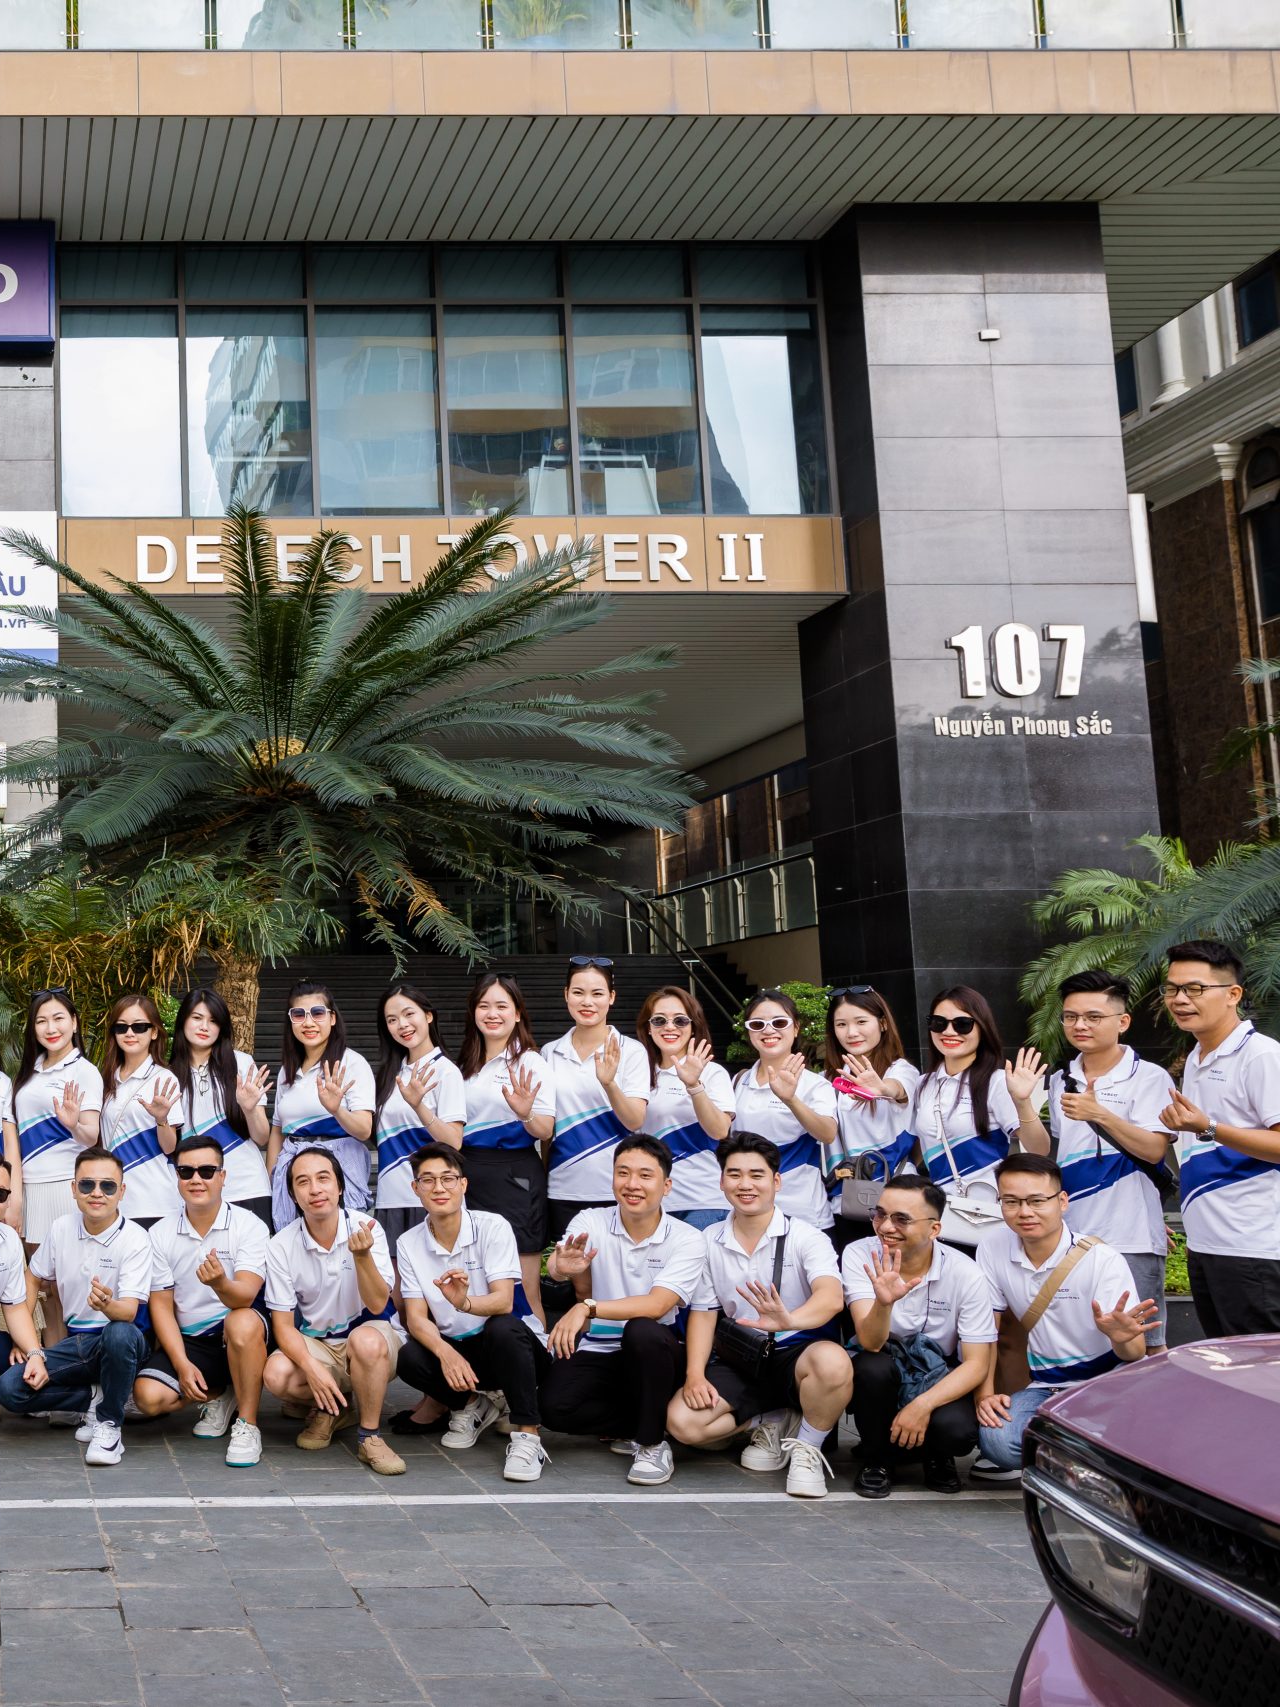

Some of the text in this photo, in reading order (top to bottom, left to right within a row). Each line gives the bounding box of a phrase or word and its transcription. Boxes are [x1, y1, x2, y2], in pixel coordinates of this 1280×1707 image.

[718, 532, 767, 583] II
[944, 622, 1086, 699] 107
[933, 710, 1113, 738] Nguyễn Phong Sắc
